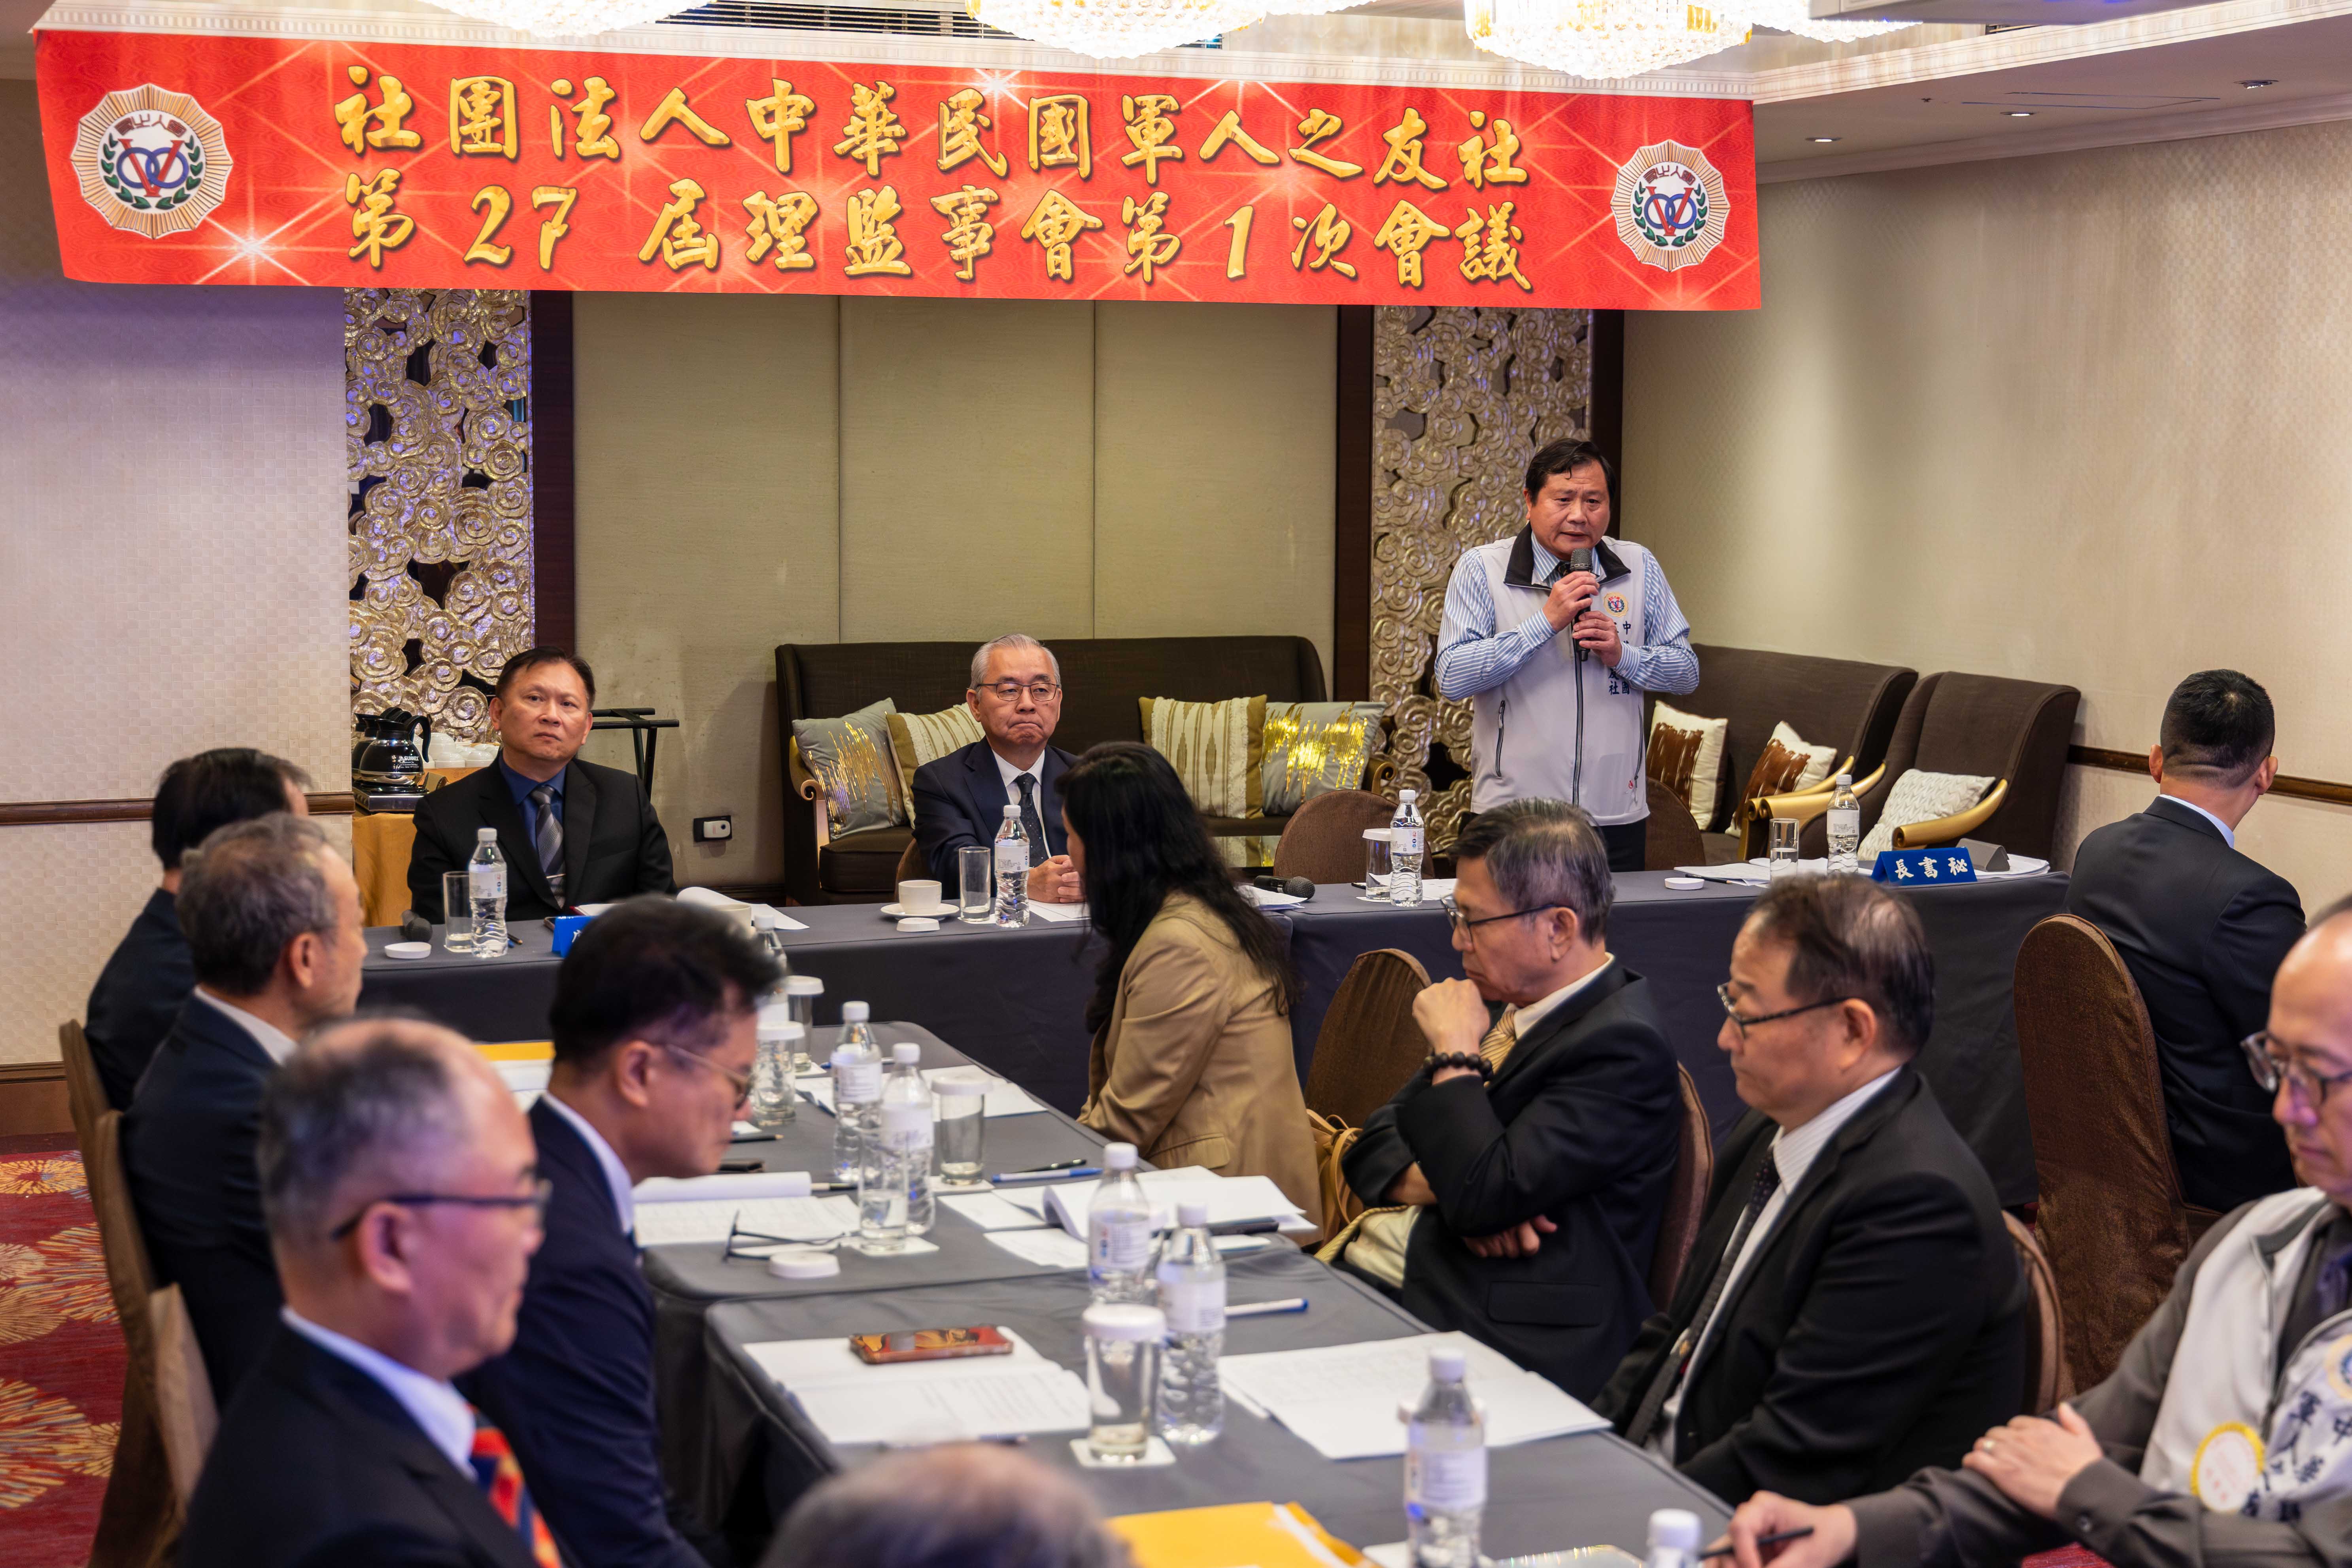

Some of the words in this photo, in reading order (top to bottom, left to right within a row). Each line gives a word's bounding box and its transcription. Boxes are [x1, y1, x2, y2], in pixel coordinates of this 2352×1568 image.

[334, 64, 1529, 190] 社團法人中華民國軍人之友社
